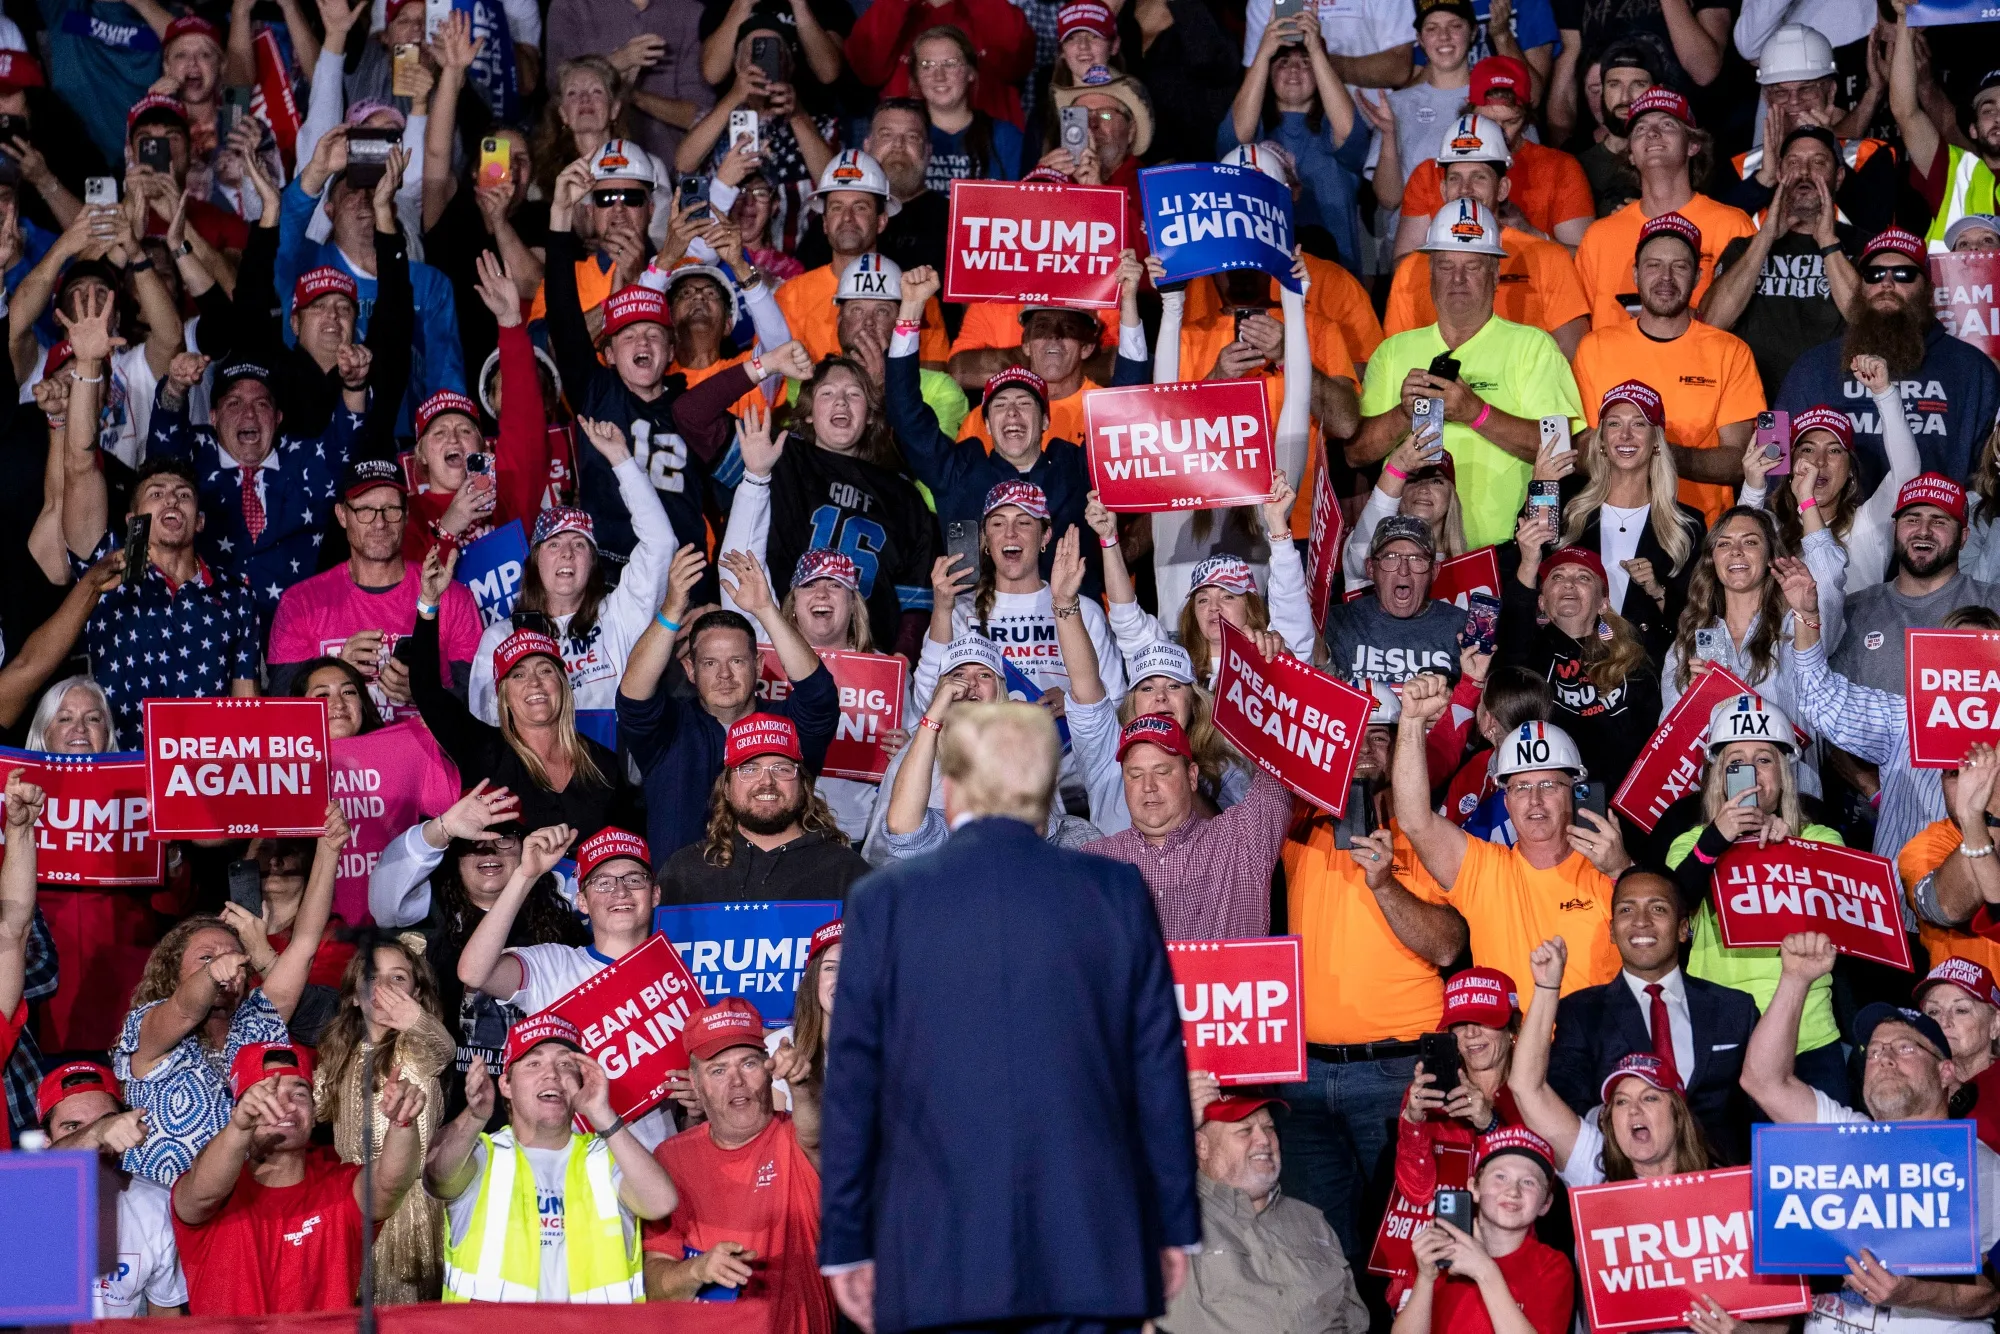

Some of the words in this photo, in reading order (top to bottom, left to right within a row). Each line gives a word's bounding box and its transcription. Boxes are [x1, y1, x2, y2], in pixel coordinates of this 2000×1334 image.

[1648, 90, 1683, 103] AMERICA
[1212, 165, 1241, 176] 2024
[1158, 194, 1183, 217] IT
[1189, 191, 1233, 210] FIX
[1238, 193, 1288, 230] WILL
[962, 216, 1116, 254] TRUMP
[1160, 210, 1293, 258] TRUMP
[1666, 215, 1699, 237] AMERICA
[1888, 230, 1922, 246] AMERICA
[1891, 238, 1917, 252] AGAIN
[961, 250, 1029, 272] WILL
[1036, 253, 1081, 274] FIX
[1087, 256, 1114, 275] IT
[1759, 253, 1828, 279] ANGR
[853, 272, 888, 294] TAX
[609, 293, 630, 308] MAKE
[630, 289, 664, 305] AMERICA
[1018, 292, 1049, 302] 2024
[1933, 284, 1993, 306] EAM
[613, 302, 636, 319] GREAT
[637, 301, 661, 314] AGAIN
[419, 398, 439, 413] MAKE
[438, 393, 473, 406] AMERICA
[1604, 384, 1625, 399] MAKE
[1625, 383, 1659, 403] AMERICA
[424, 406, 447, 419] GREAT
[1794, 410, 1815, 426] MAKE
[1099, 415, 1259, 458] TRUMP
[631, 418, 687, 492] 12
[1103, 457, 1176, 480] WILL
[1183, 451, 1228, 475] FIX
[1235, 448, 1261, 470] IT
[354, 459, 397, 475] Trump
[1902, 478, 1923, 493] MAKE
[1922, 476, 1961, 496] AMERICA
[829, 481, 873, 512] GOFF
[1171, 496, 1202, 508] 2024
[1903, 489, 1926, 504] GREAT
[1927, 489, 1955, 505] AGAIN
[496, 637, 518, 655] MAKE
[518, 631, 554, 646] AMERICA
[503, 643, 528, 661] GREAT
[530, 643, 553, 653] AGAIN
[968, 637, 1001, 653] AMERICA
[1133, 648, 1151, 660] MAKE
[1152, 645, 1185, 659] AMERICA
[950, 649, 973, 660] GREAT
[975, 649, 996, 662] AGAIN
[1135, 658, 1156, 672] GREAT
[1160, 658, 1183, 669] AGAIN
[1352, 645, 1452, 673] JESUS
[1366, 671, 1390, 682] MY
[1921, 668, 2000, 692] DREA
[839, 686, 892, 716] BIG,
[1229, 648, 1298, 719] DREAM
[1302, 704, 1351, 750] BIG,
[1580, 705, 1605, 717] 2020
[732, 723, 755, 739] MAKE
[755, 719, 791, 735] AMERICA
[1124, 719, 1173, 736] TRUMP
[1225, 678, 1336, 773] AGAIN!
[1730, 713, 1771, 737] TAX
[736, 735, 761, 750] GREAT
[763, 733, 787, 747] AGAIN
[1651, 722, 1674, 751] 2024
[159, 737, 262, 760] DREAM
[269, 736, 322, 761] BIG,
[1516, 739, 1550, 766] NO
[1258, 757, 1282, 778] 2024
[1661, 755, 1697, 800] FIX
[164, 763, 312, 797] AGAIN!
[228, 824, 260, 834] 2024
[66, 831, 115, 852] FIX
[122, 831, 149, 852] IT
[582, 836, 609, 854] MAKE
[609, 830, 645, 848] AMERICA
[1788, 838, 1819, 851] 2024
[587, 847, 616, 863] GREAT
[617, 844, 642, 857] AGAIN
[47, 871, 81, 881] 2024
[1727, 865, 1757, 885] IT
[1762, 863, 1812, 886] FIX
[1816, 869, 1887, 906] WILL
[1730, 884, 1894, 937] TRUMP
[1948, 960, 1983, 979] AMERICA
[1951, 970, 1977, 986] AGAIN
[639, 971, 688, 1012] BIG,
[697, 974, 730, 995] ILL
[739, 971, 785, 993] FIX
[1445, 978, 1463, 994] MAKE
[1463, 976, 1502, 992] AMERICA
[1174, 980, 1289, 1022] UMP
[1470, 993, 1497, 1006] AGAIN
[515, 1017, 541, 1034] MAKE
[702, 1013, 727, 1024] MAKE
[707, 1021, 729, 1031] GREAT
[520, 1028, 550, 1044] GREAT
[596, 995, 691, 1080] GAIN!
[1196, 1020, 1249, 1047] FIX
[1258, 1018, 1288, 1043] IT
[1485, 1129, 1513, 1144] MAKE
[1769, 1163, 1889, 1190] DREAM
[1899, 1162, 1965, 1192] BIG,
[1773, 1192, 1950, 1230] AGAIN!
[1590, 1210, 1749, 1266] TRUM
[1598, 1262, 1686, 1294] WILL
[1692, 1252, 1748, 1283] FIX
